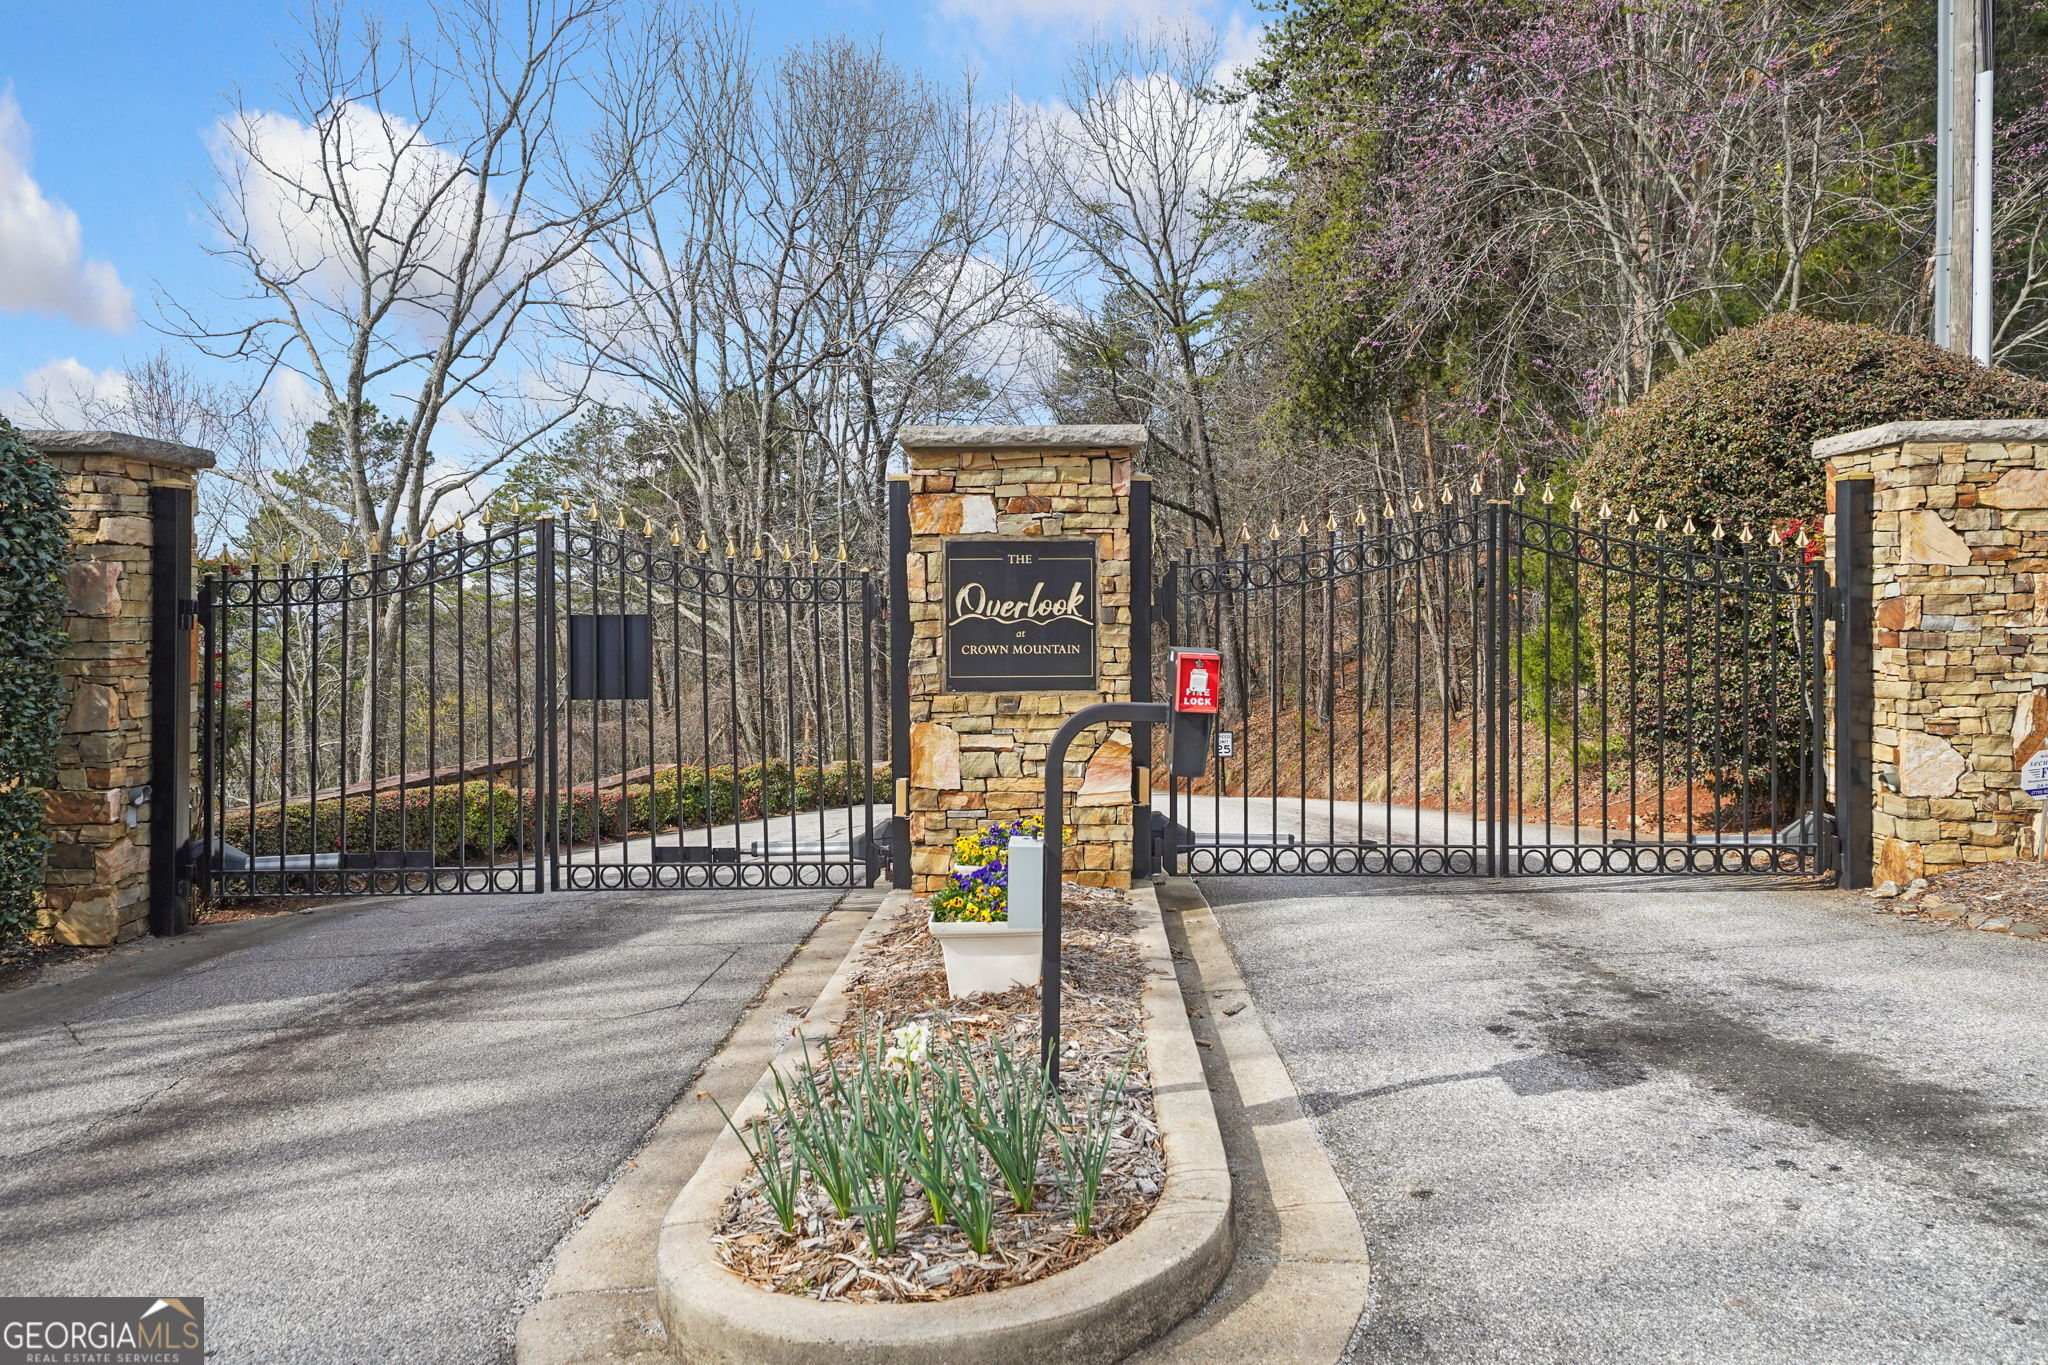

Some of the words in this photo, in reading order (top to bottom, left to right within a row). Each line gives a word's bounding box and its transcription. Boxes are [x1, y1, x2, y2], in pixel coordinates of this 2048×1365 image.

[1007, 554, 1033, 564] THE
[955, 581, 1085, 619] Overlook
[1015, 630, 1026, 638] at
[961, 644, 1009, 655] CROWN
[1012, 644, 1081, 655] MOUNTAIN
[1184, 698, 1212, 706] LOCK
[1218, 745, 1231, 754] 25
